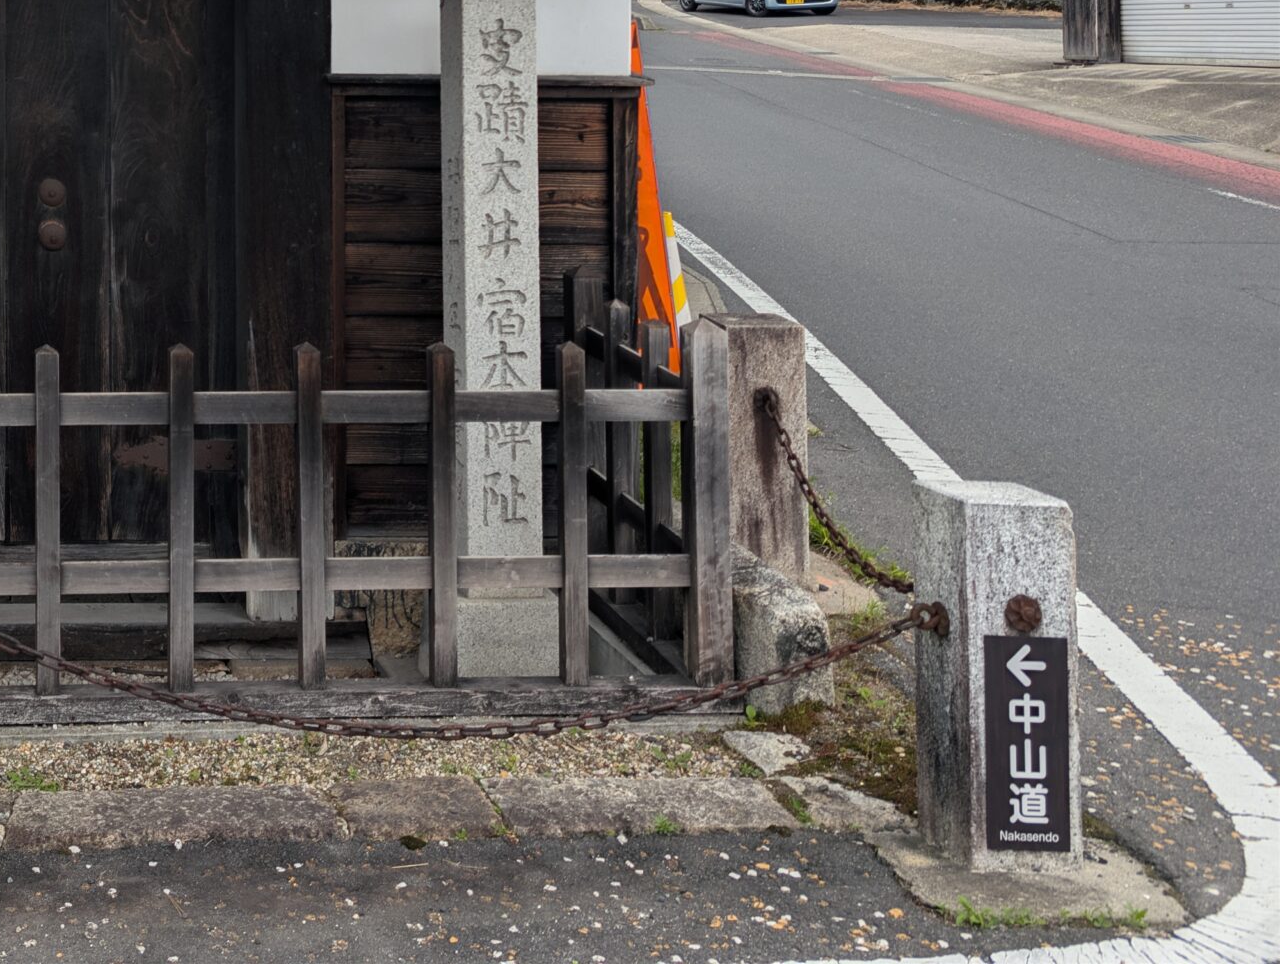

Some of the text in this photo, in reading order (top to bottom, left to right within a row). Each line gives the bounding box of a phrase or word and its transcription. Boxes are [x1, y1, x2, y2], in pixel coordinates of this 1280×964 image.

[1008, 692, 1049, 825] 中山道
[999, 829, 1060, 843] Nakasendo
